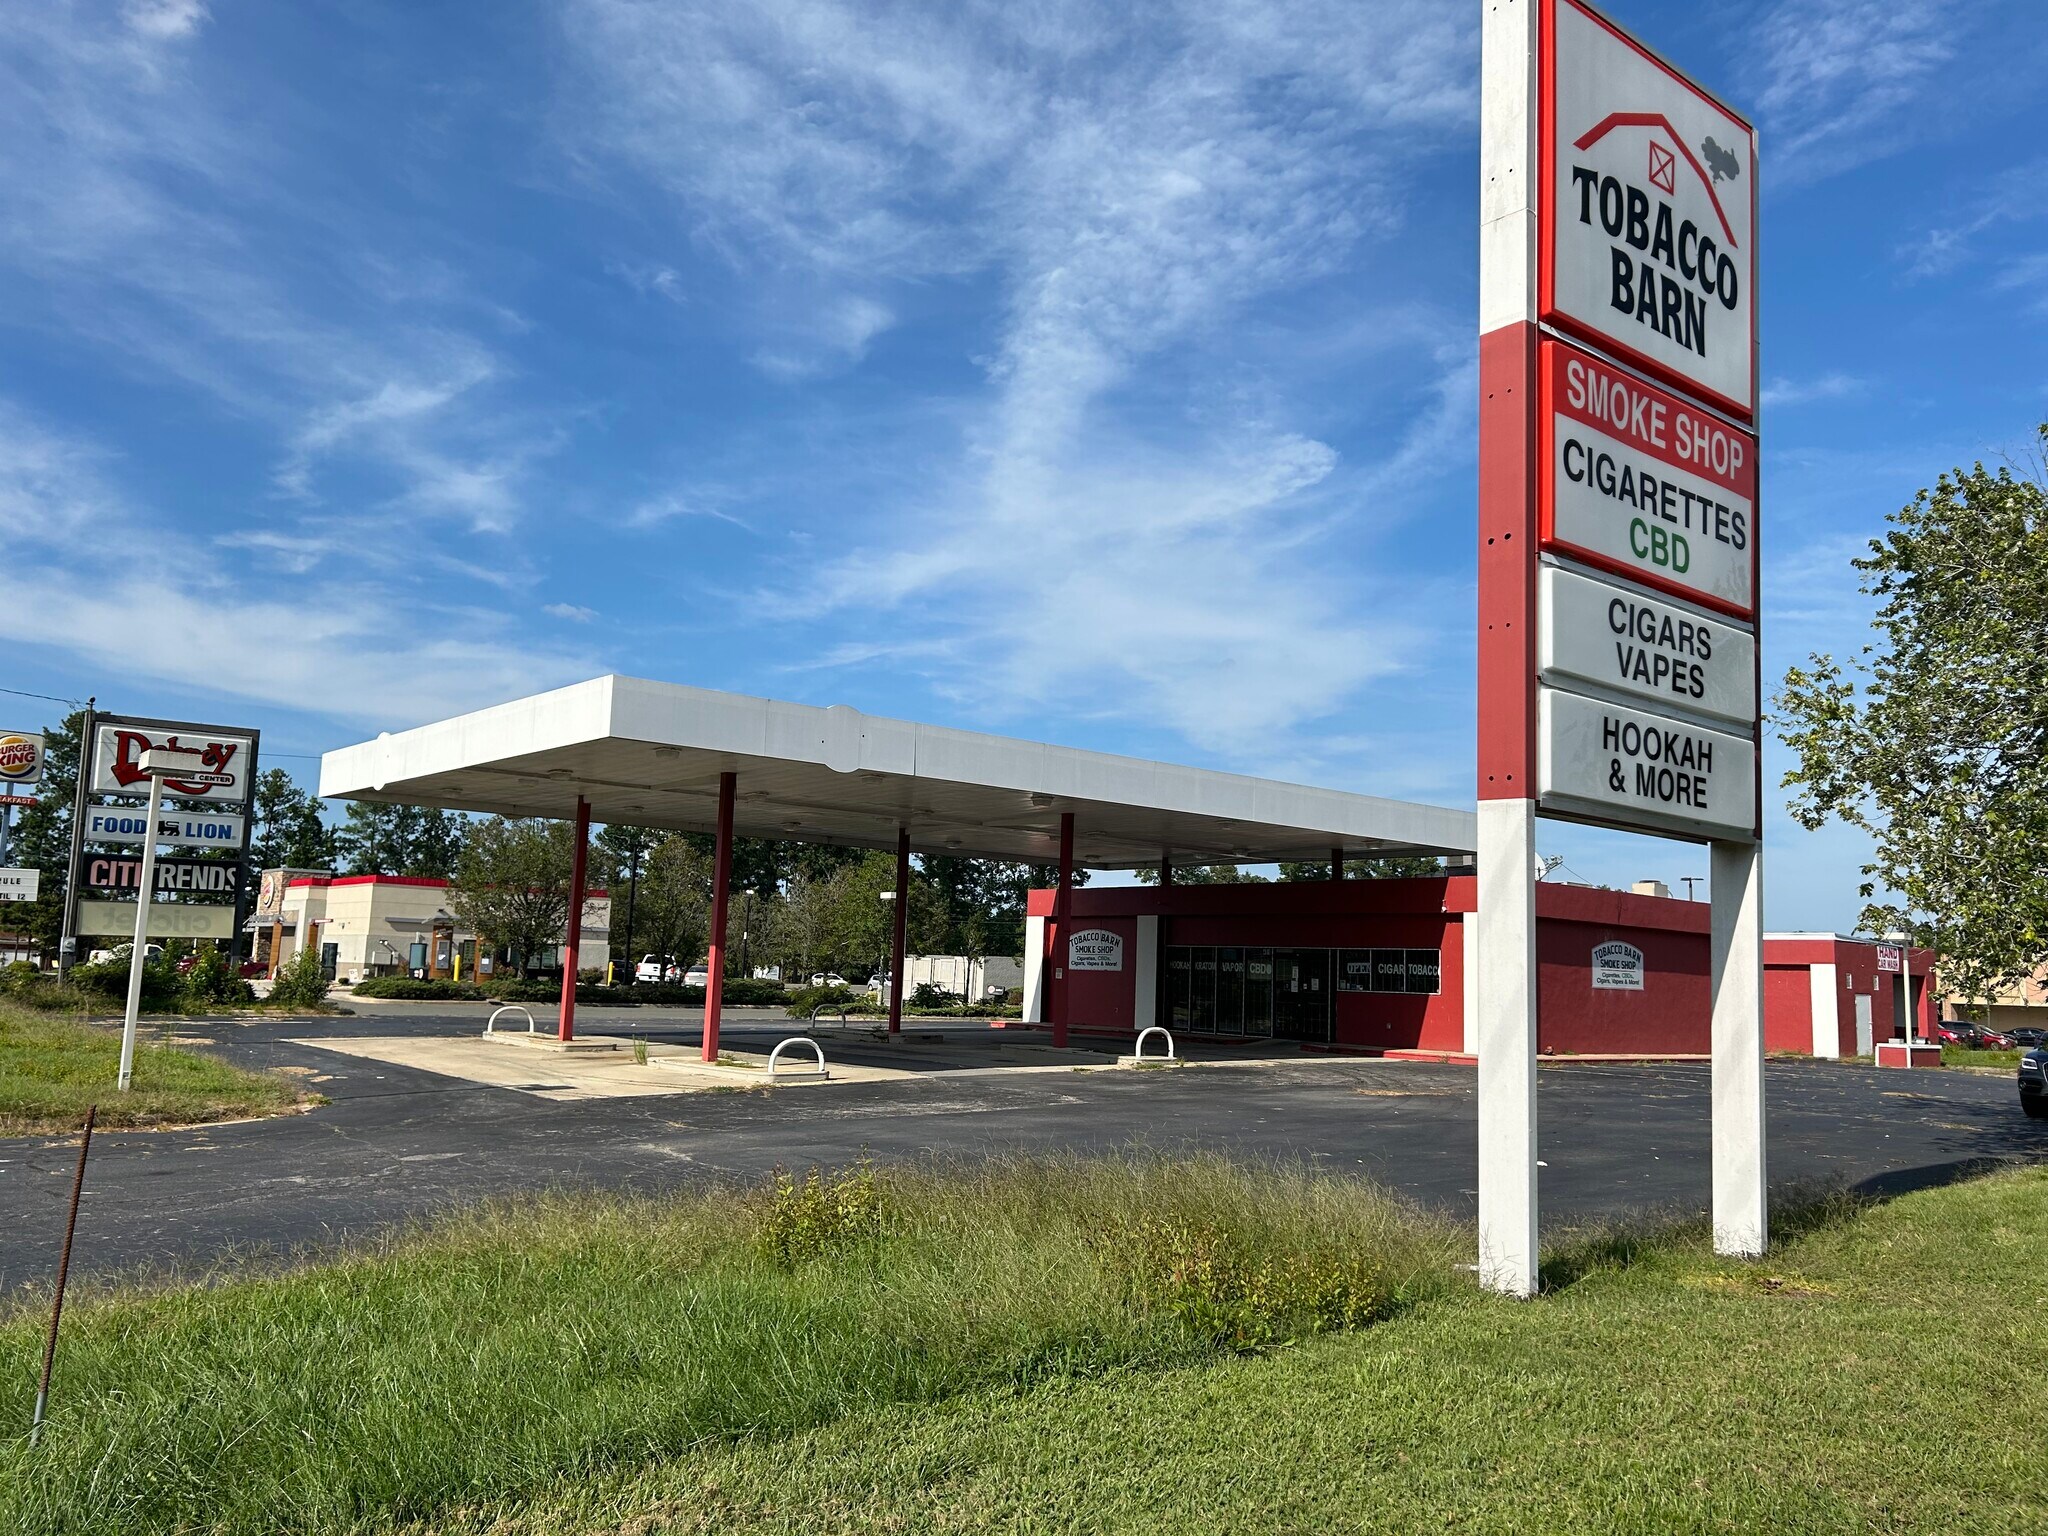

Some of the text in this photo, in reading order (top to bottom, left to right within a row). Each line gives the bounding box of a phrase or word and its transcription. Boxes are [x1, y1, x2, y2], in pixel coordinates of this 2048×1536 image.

[1573, 164, 1738, 311] TOBACCO
[1610, 245, 1706, 358] BARN
[1567, 360, 1743, 480] SMOKE SHOP
[1563, 438, 1746, 550] CIGARETTES
[1629, 517, 1690, 574] CBD
[1608, 598, 1712, 661] CIGARS
[1616, 641, 1705, 698] VAPES
[0, 744, 35, 755] URGER
[113, 730, 237, 776] Dey
[1603, 716, 1713, 774] HOOKAH
[198, 774, 231, 783] CENTER
[1608, 758, 1708, 809] & MORE
[92, 816, 232, 840] FOOD LION
[90, 859, 143, 888] CITI
[154, 863, 237, 891] RENDS
[1070, 932, 1120, 947] TOBACCO BARN
[1075, 945, 1114, 954] SMOKE SHOP
[1594, 944, 1641, 963] TOBACCO BARN
[1879, 946, 1898, 959] HAND
[1600, 959, 1636, 970] SMOKE SHOP
